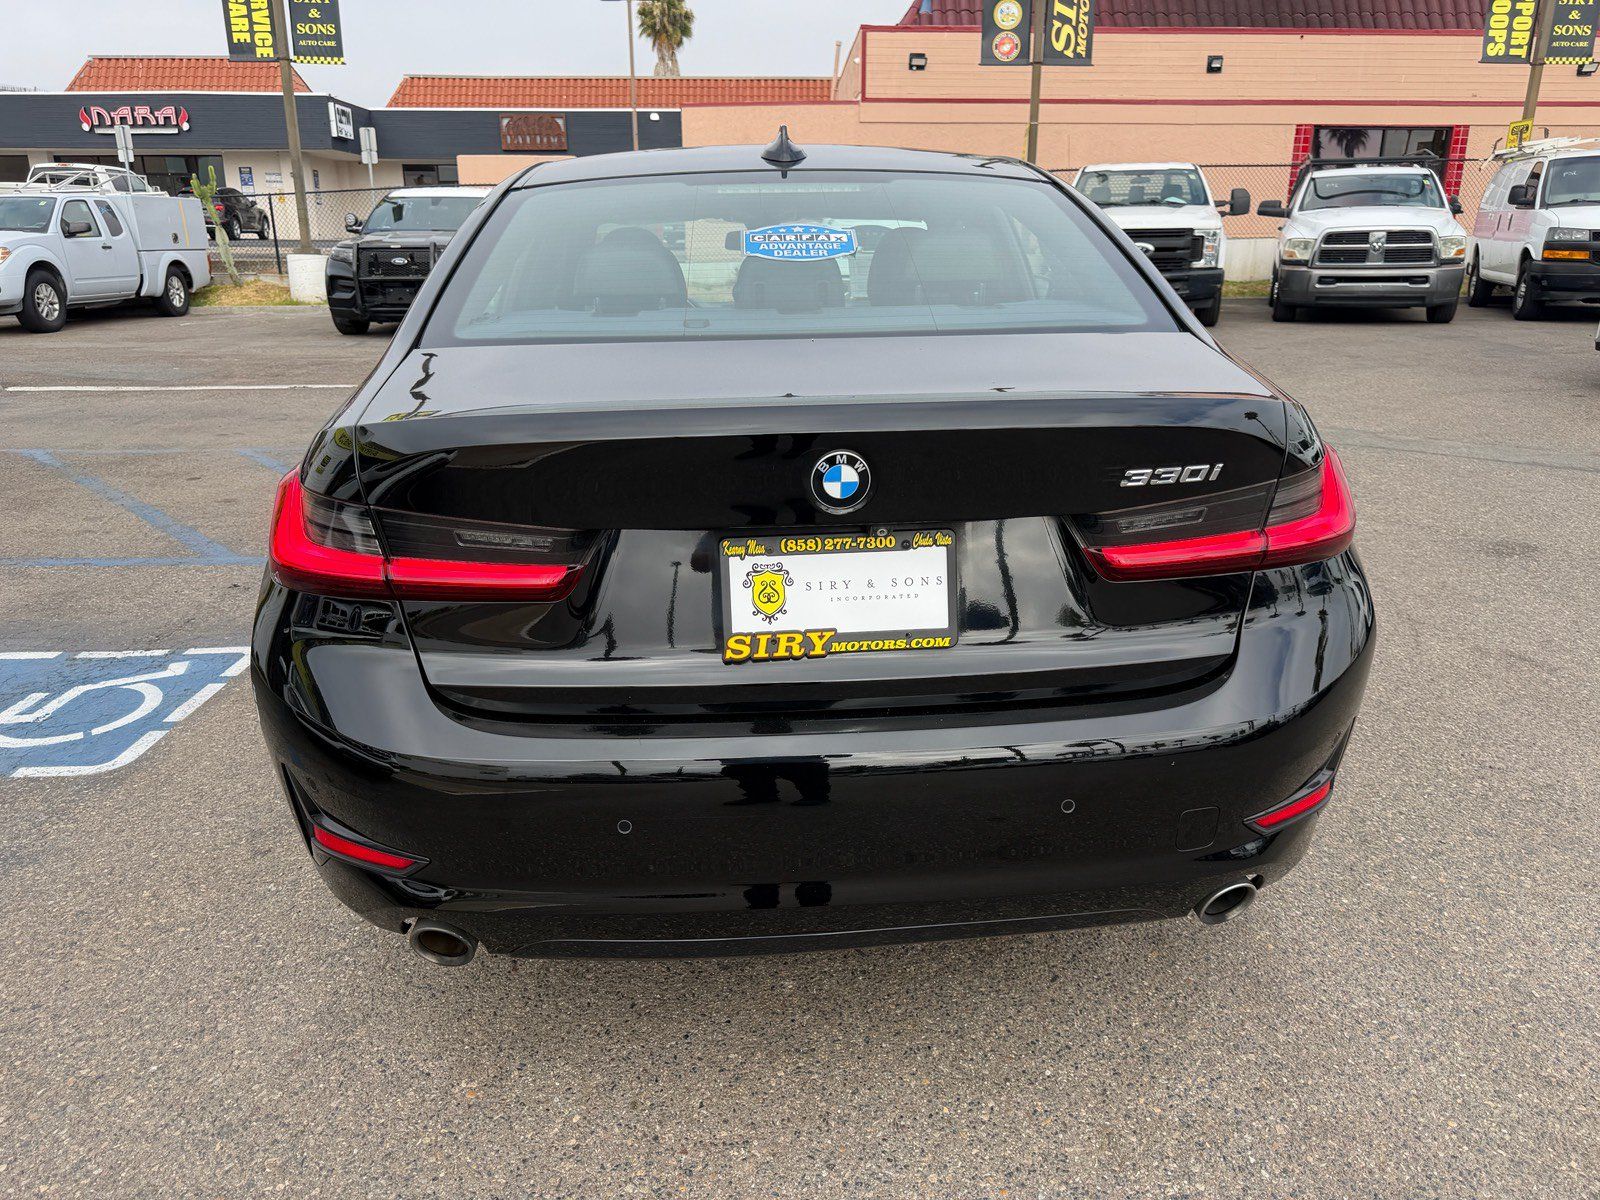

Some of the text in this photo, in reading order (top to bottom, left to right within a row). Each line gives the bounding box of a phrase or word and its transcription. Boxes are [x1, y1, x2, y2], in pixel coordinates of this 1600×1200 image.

[308, 8, 321, 18] &
[1568, 10, 1581, 20] &
[228, 0, 251, 43] ARE
[296, 23, 336, 35] SONS
[1553, 24, 1592, 36] SONS
[90, 106, 177, 125] NARA
[752, 233, 848, 242] CARFAX
[759, 242, 842, 250] ADVANTAGE
[817, 454, 866, 473] BMW
[1119, 463, 1224, 487] 330i
[780, 535, 896, 553] (858) 277-7300
[913, 531, 952, 548] Chula Vista
[746, 540, 766, 554] Mesa
[805, 576, 943, 591] SIRY & SONS
[829, 593, 919, 601] INCORPORATED
